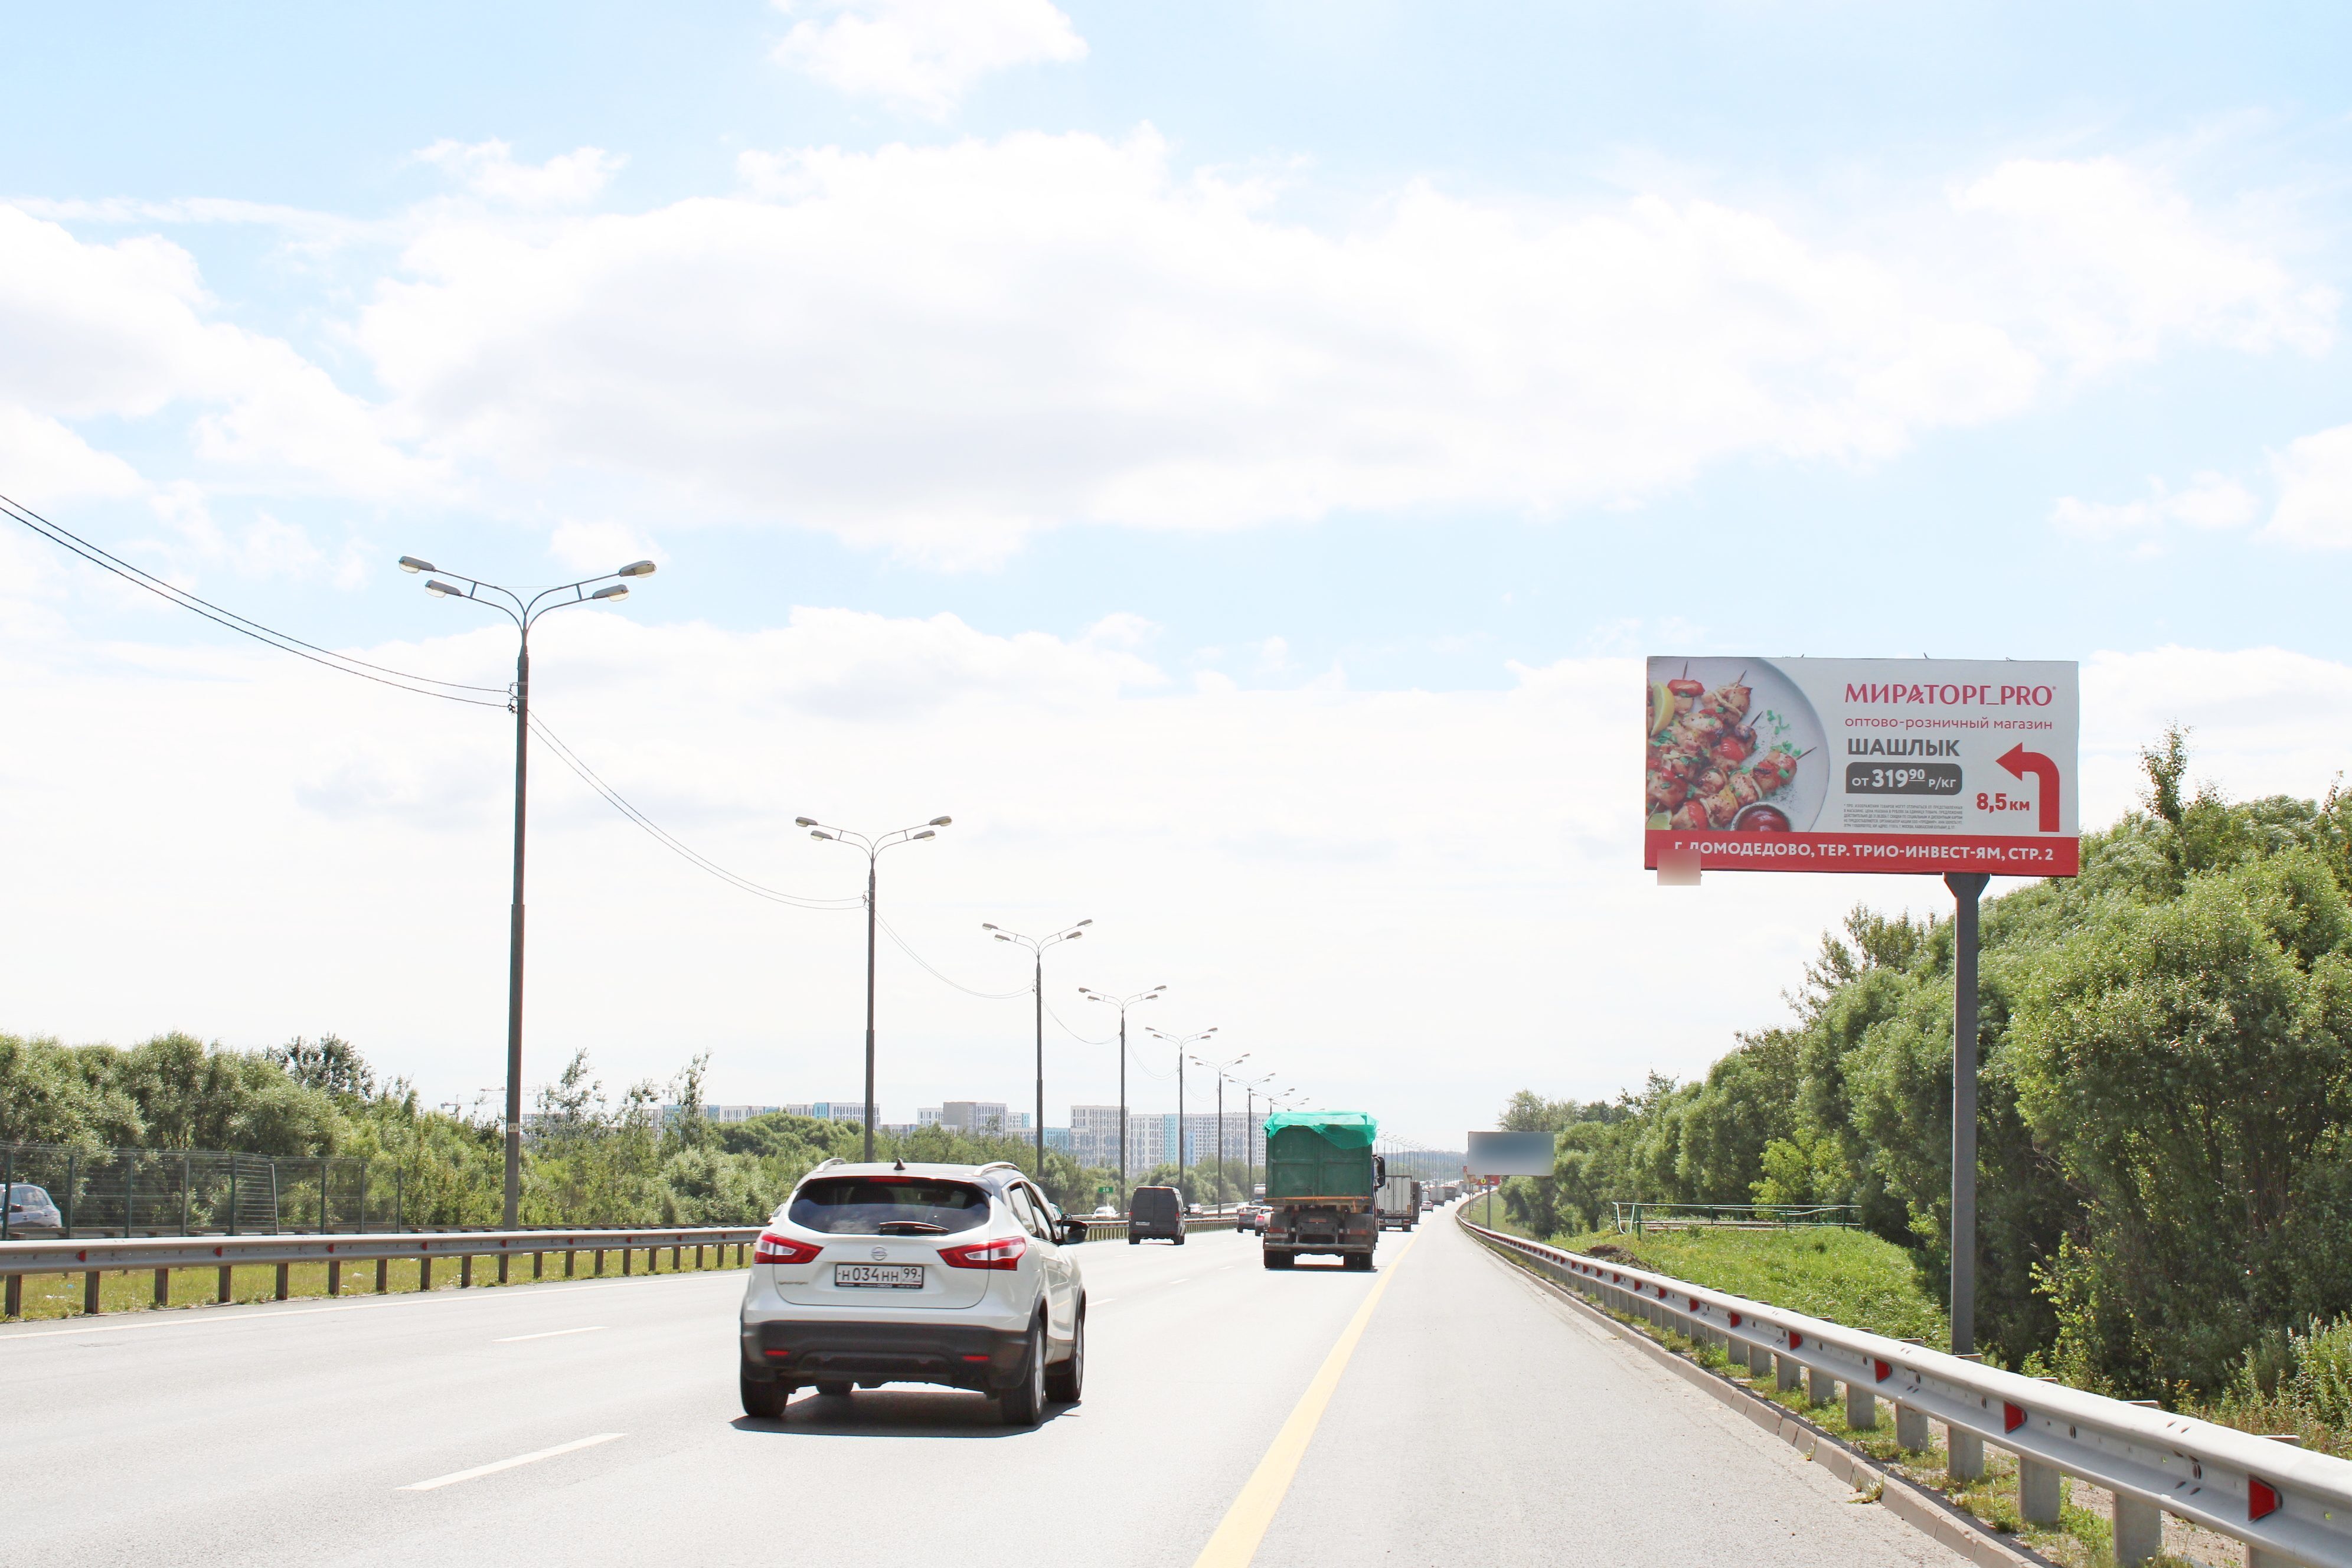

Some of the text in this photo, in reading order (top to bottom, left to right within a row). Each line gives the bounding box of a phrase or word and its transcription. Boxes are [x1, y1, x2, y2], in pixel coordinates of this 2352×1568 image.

[1845, 717, 2052, 730] оптово-розничный магазин
[1848, 739, 1960, 756] ШАШЛЫК
[1977, 793, 2007, 814] 8,5
[1818, 844, 1850, 857] ТЕР.
[1853, 845, 2005, 861] ТРИО-ИНВЕСТ-ЯМ,
[2008, 848, 2042, 860] СТР.
[2045, 848, 2053, 860] 2
[903, 1268, 917, 1278] 99
